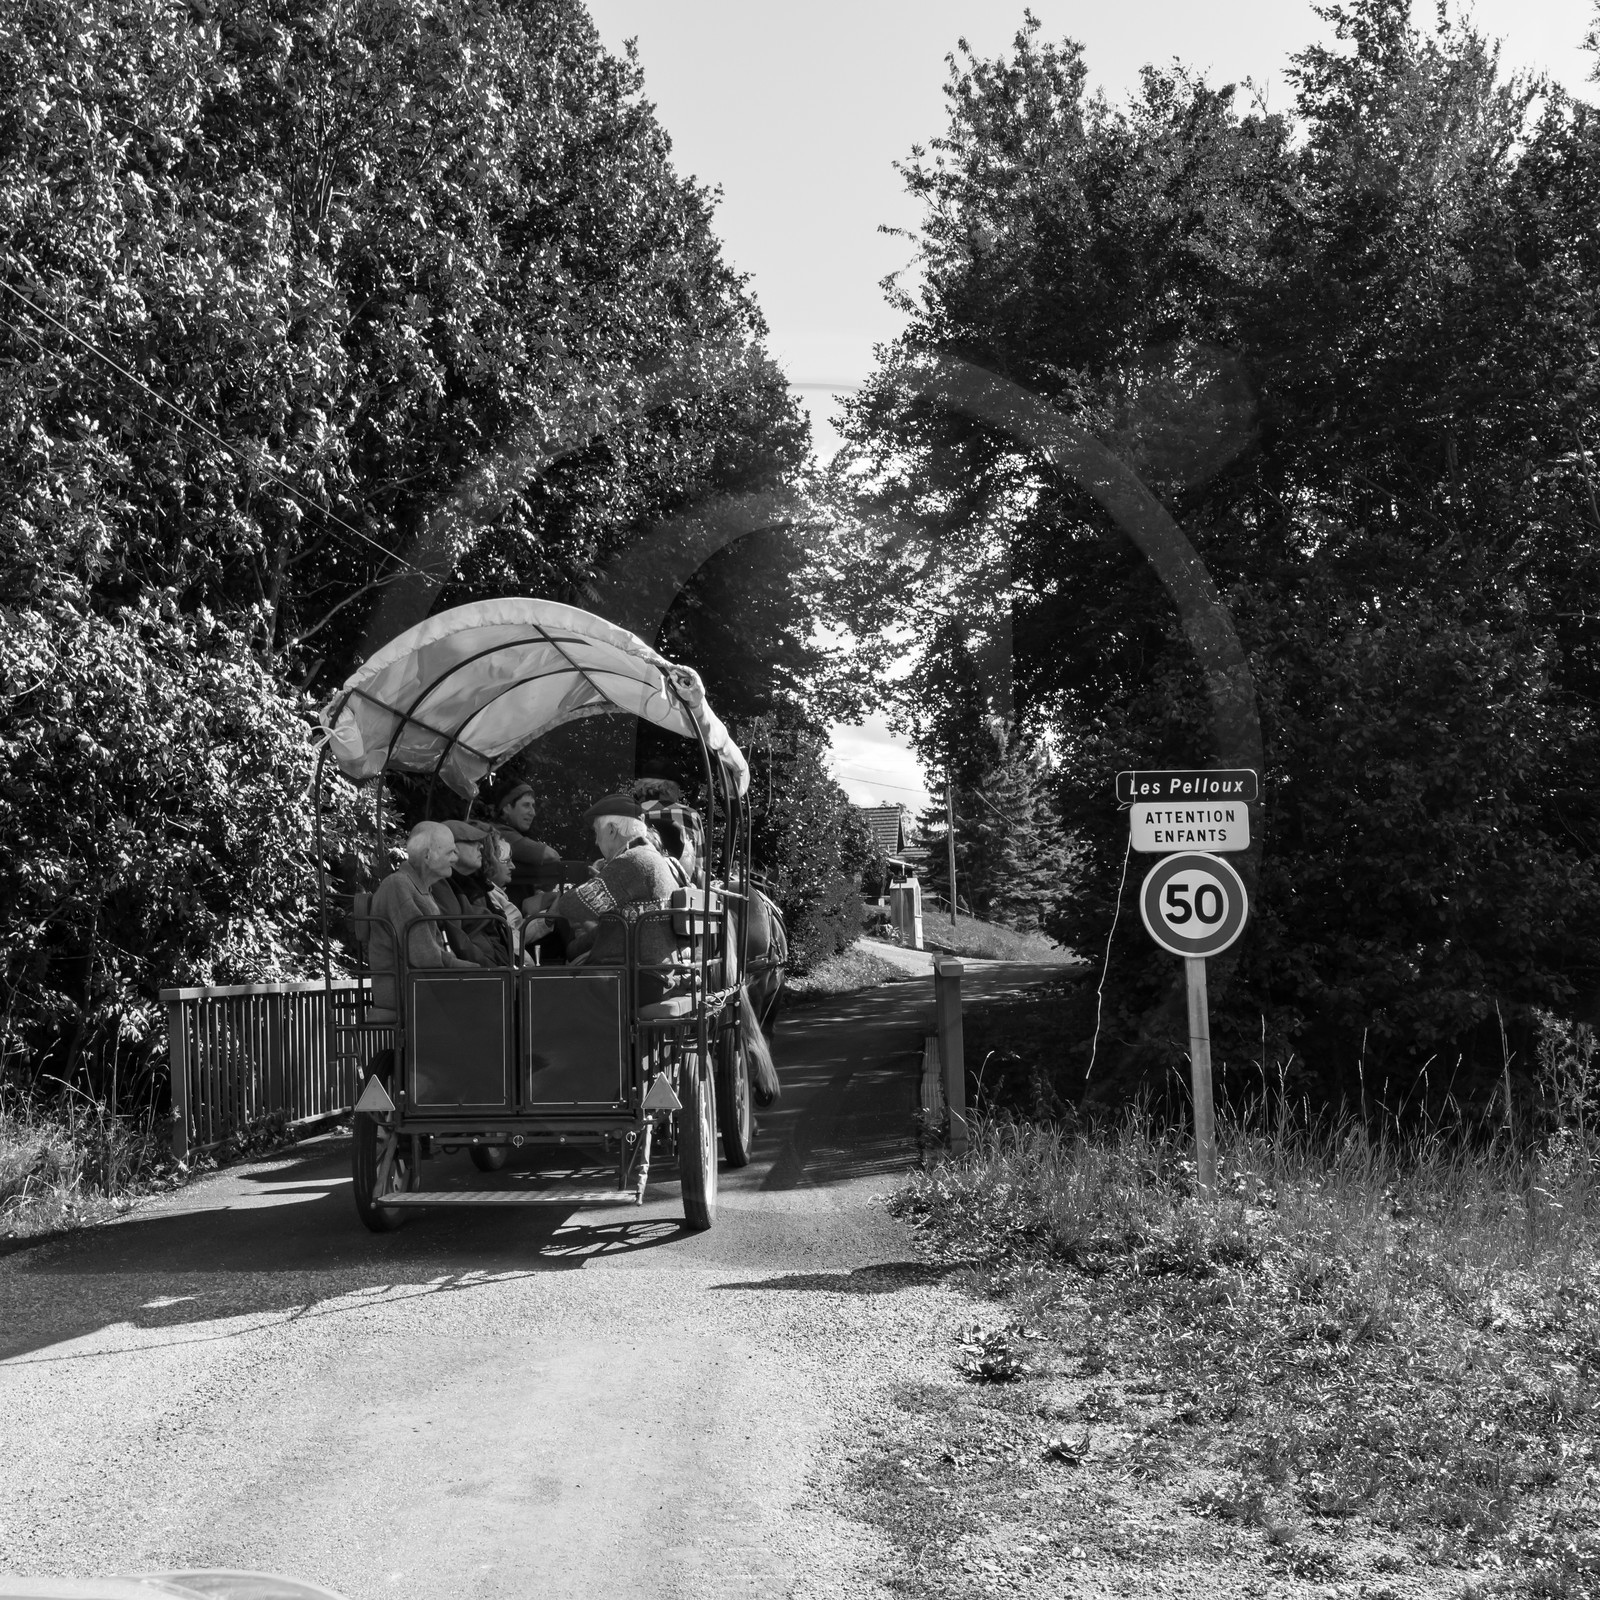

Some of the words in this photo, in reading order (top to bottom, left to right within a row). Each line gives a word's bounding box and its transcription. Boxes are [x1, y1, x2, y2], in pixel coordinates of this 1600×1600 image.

[1130, 779, 1161, 795] Les
[1170, 778, 1244, 794] Pelloux
[1145, 810, 1235, 824] ATTENTION
[1154, 829, 1227, 842] ENFANTS
[1165, 884, 1224, 924] 50
